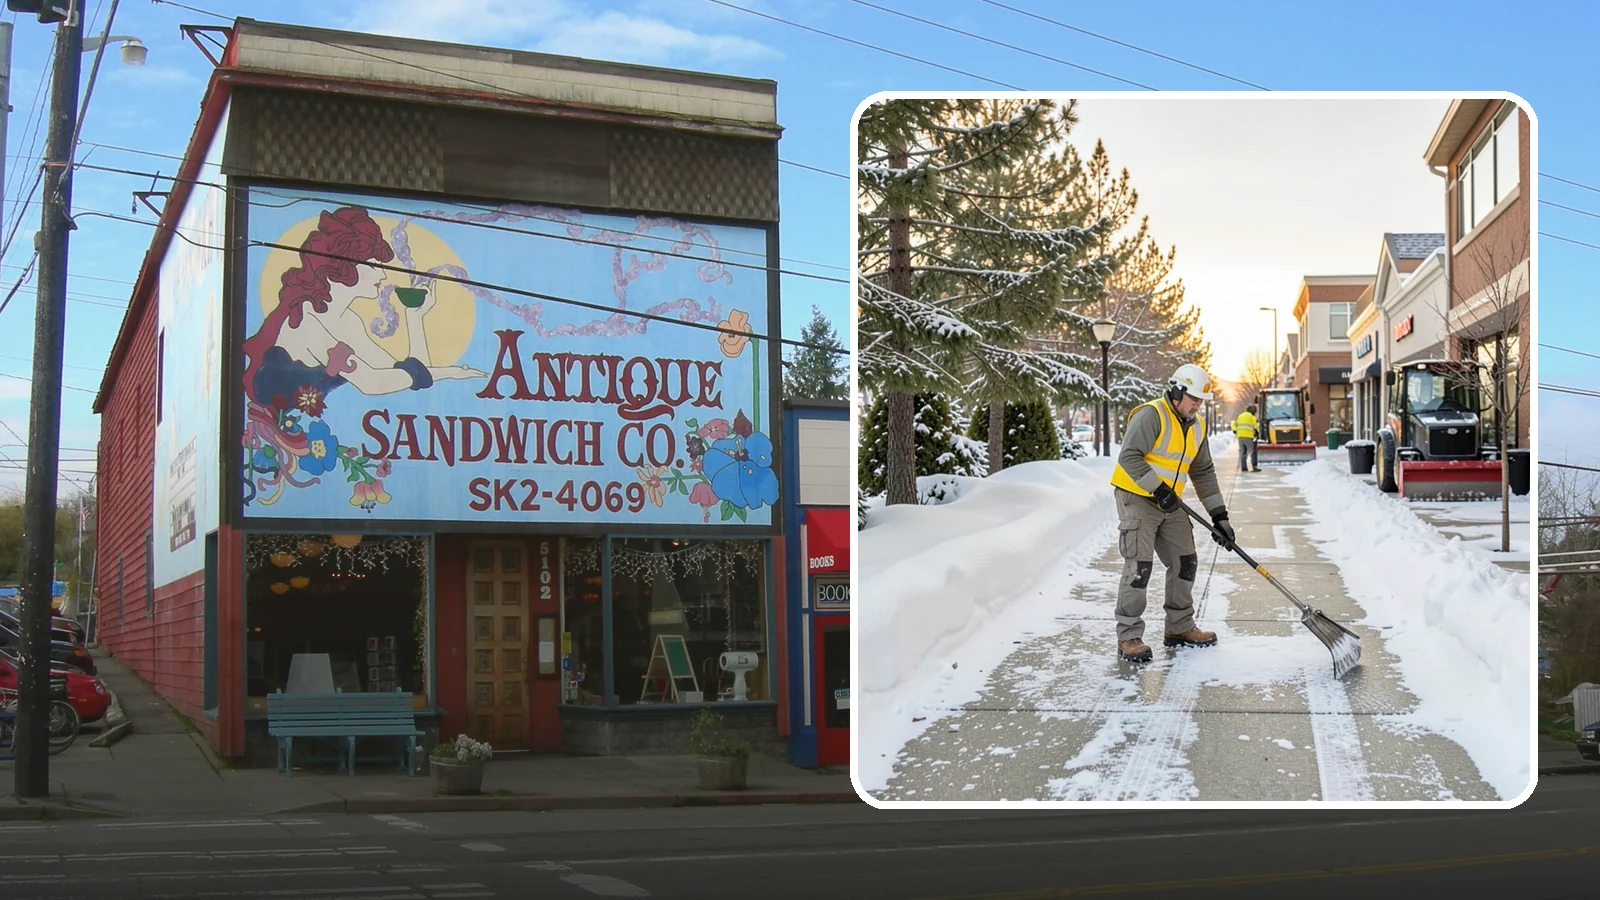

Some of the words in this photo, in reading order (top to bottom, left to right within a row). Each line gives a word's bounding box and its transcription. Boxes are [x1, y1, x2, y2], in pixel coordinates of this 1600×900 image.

[476, 329, 723, 421] ANTIQUE
[361, 409, 604, 467] SANDWICH
[617, 421, 685, 468] CO.
[468, 477, 645, 513] SK2-4069
[539, 541, 552, 600] 5102
[809, 555, 835, 569] BOOKS
